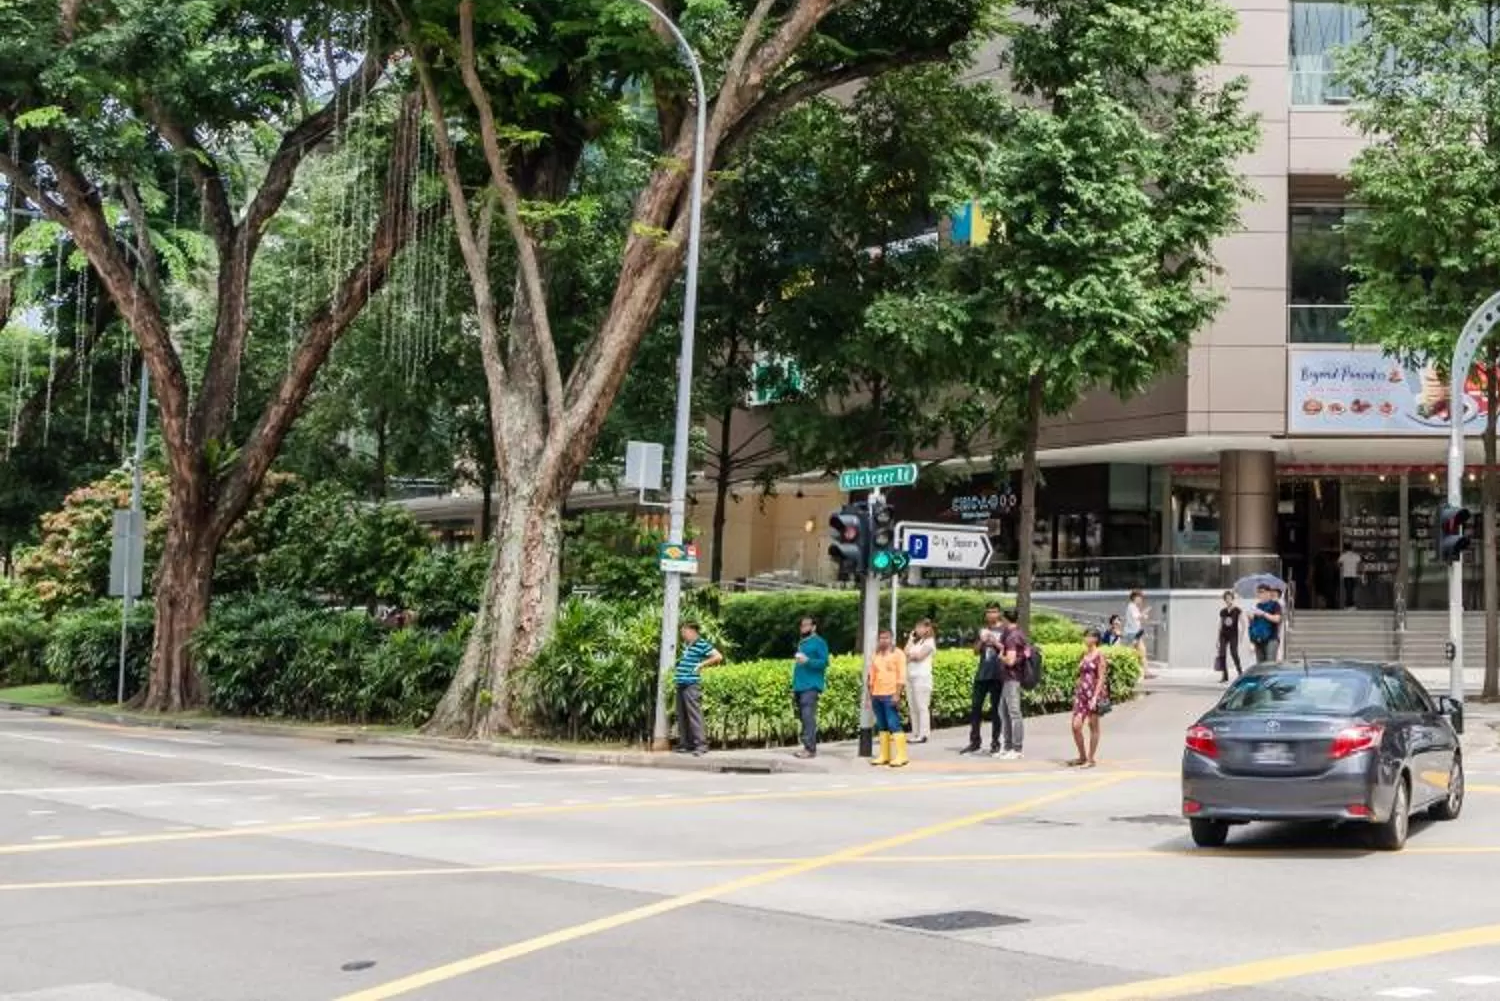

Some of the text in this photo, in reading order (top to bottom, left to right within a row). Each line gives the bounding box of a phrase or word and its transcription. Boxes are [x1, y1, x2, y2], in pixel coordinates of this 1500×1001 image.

[844, 468, 910, 488] Kitchener Rd
[914, 538, 923, 554] P
[932, 534, 949, 549] City
